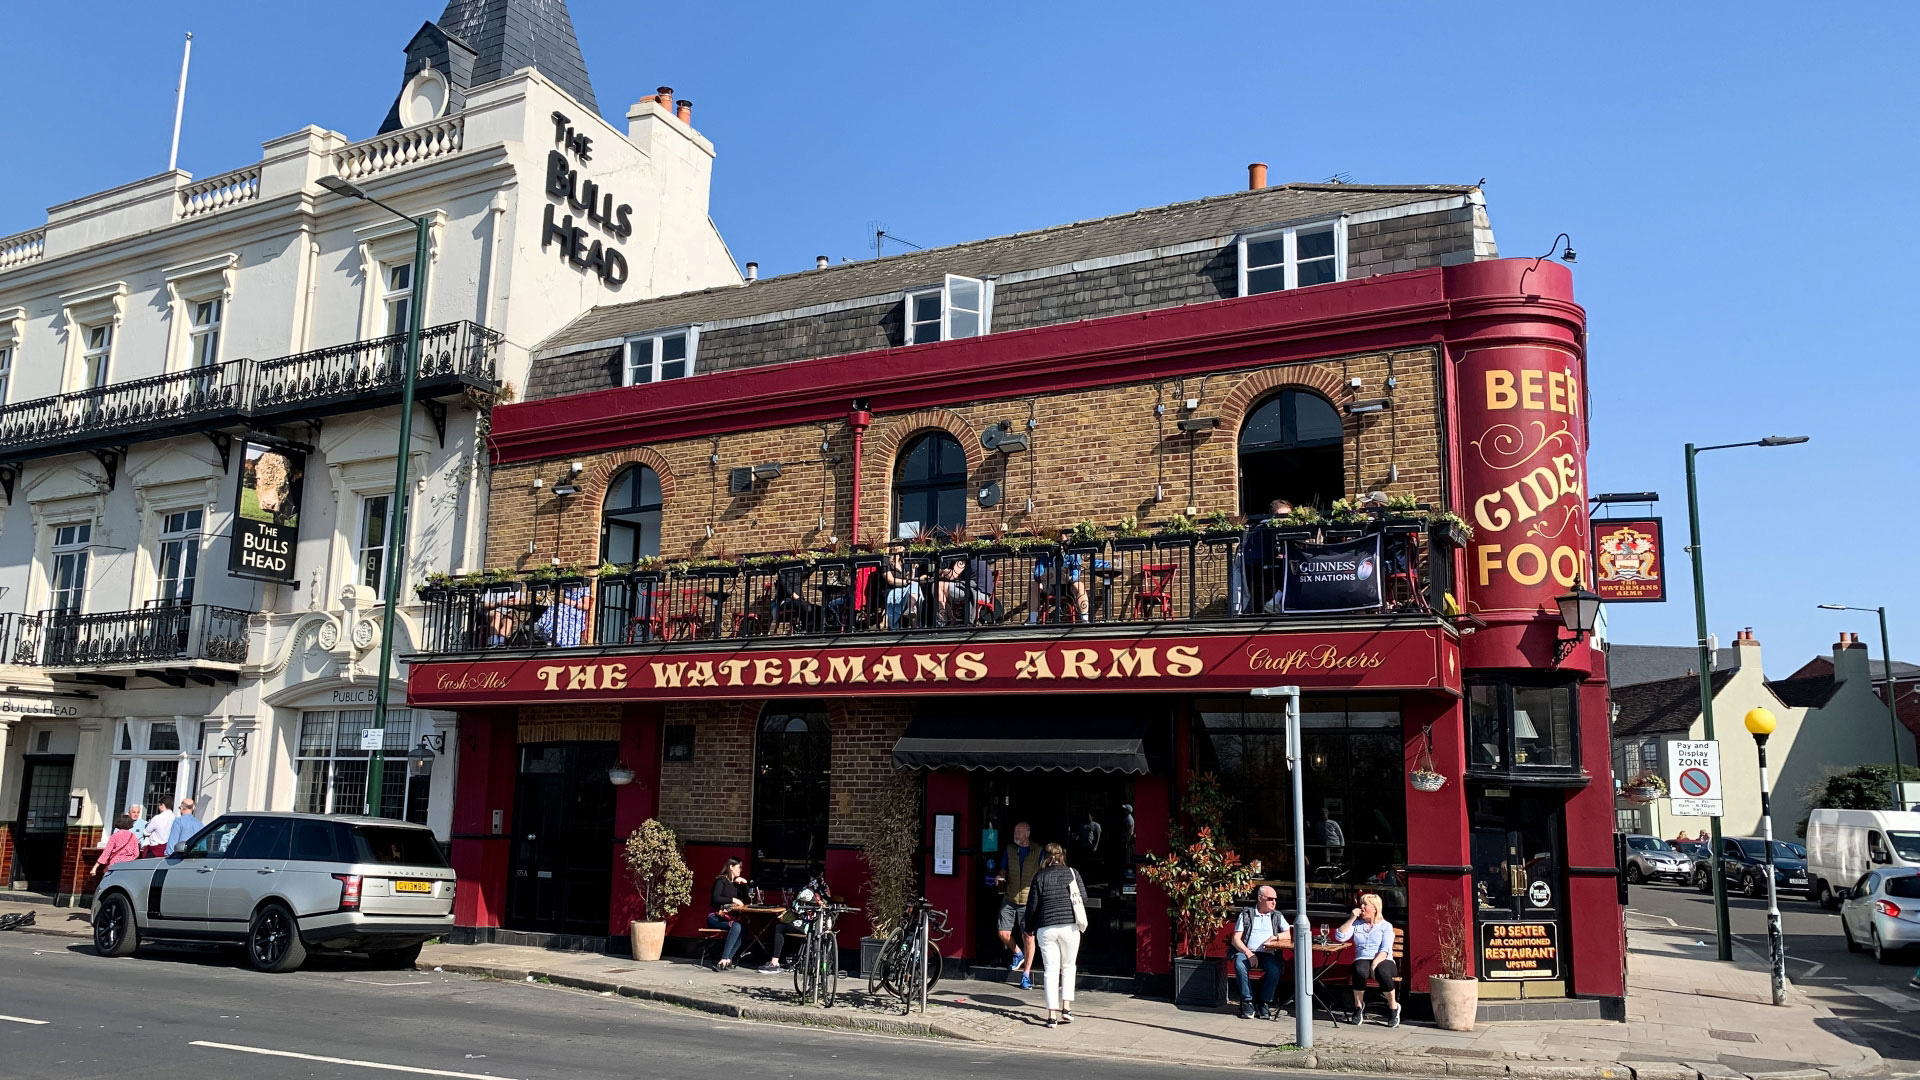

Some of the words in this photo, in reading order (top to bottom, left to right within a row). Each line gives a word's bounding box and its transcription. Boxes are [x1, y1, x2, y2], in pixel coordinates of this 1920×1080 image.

[551, 111, 593, 161] THE
[546, 150, 632, 237] BULLS
[543, 203, 629, 285] HEAD
[1485, 369, 1578, 418] BEER
[258, 524, 278, 537] THE
[243, 532, 288, 554] BULLS
[242, 550, 286, 571] HEAD
[1300, 560, 1356, 572] GUINNESS
[1300, 575, 1313, 583] SIX
[1314, 573, 1356, 582] NATIONS
[1247, 643, 1308, 675] Craft
[1306, 644, 1385, 670] Beers
[537, 663, 628, 691] THE
[650, 651, 988, 688] WATERMANS
[1015, 645, 1204, 680] ARMS
[436, 670, 469, 690] Cask
[468, 671, 511, 689] Ales
[332, 690, 364, 702] PUBLIC
[2, 701, 39, 713] BULLS
[43, 703, 77, 716] HEAD
[1493, 925, 1506, 936] 50
[1508, 925, 1546, 936] SEATER
[1489, 938, 1502, 946] AIR
[1485, 947, 1555, 959] RESTAURANT
[1506, 960, 1537, 968] UPSTAIRS
